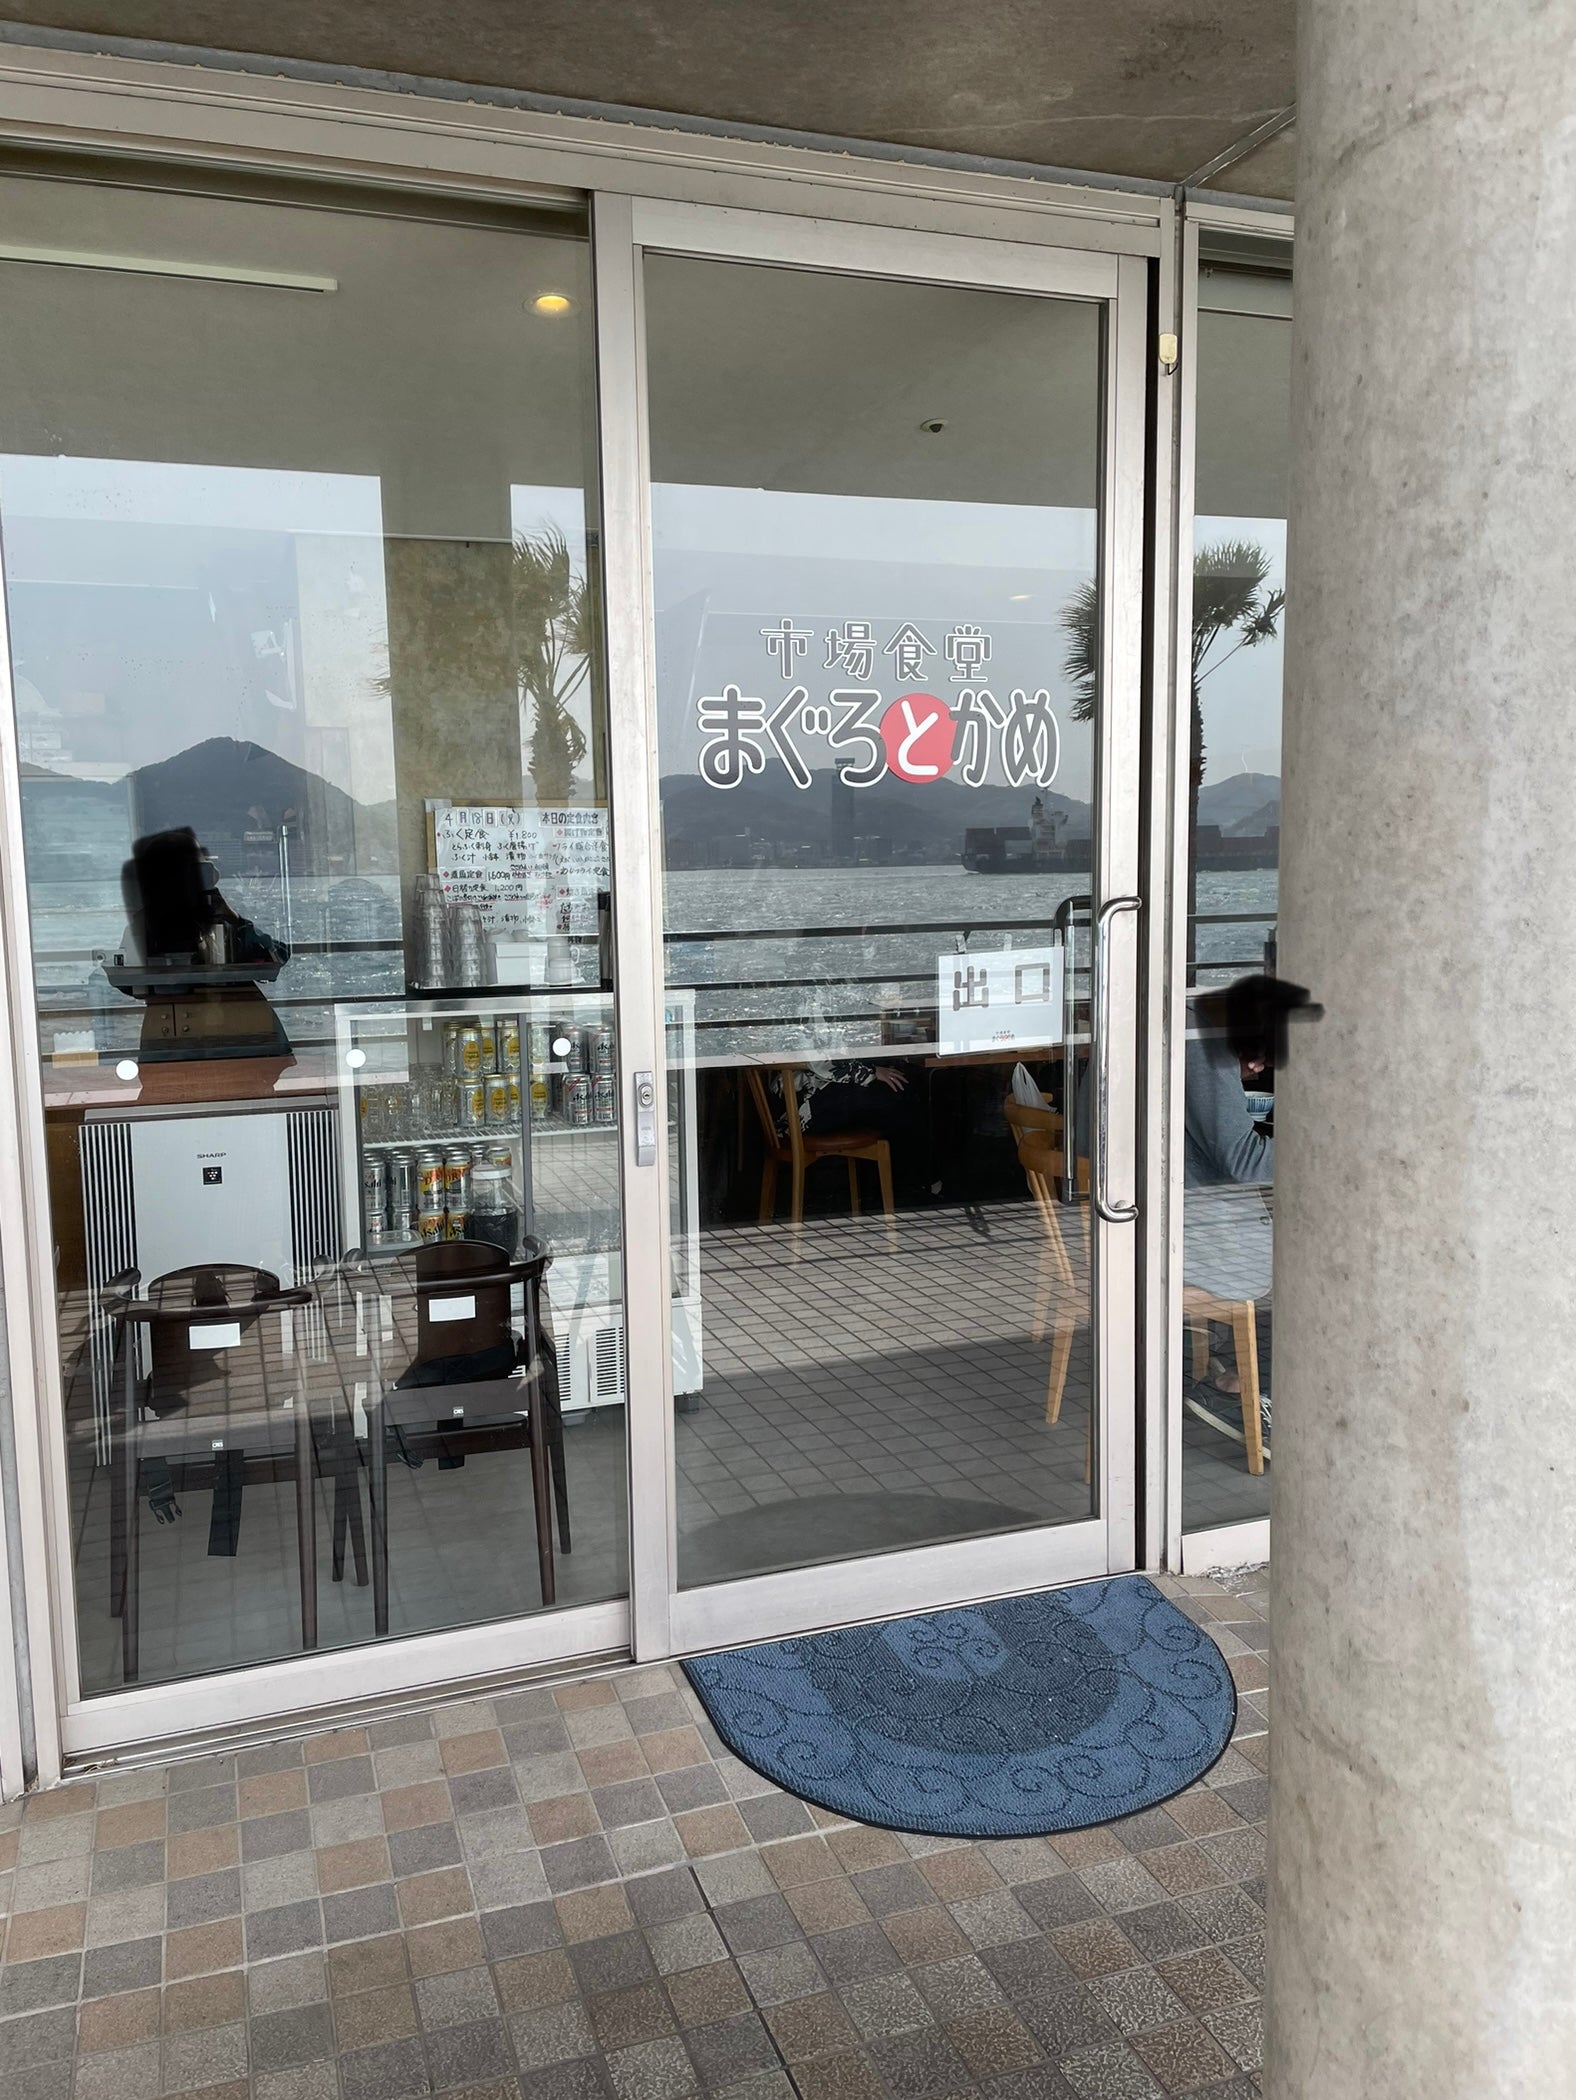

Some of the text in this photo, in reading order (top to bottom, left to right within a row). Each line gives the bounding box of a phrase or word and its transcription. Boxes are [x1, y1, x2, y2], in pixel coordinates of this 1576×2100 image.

[759, 618, 993, 683] 市場食堂
[697, 684, 1061, 790] まぐろとかめ
[953, 961, 1051, 1012] 出口
